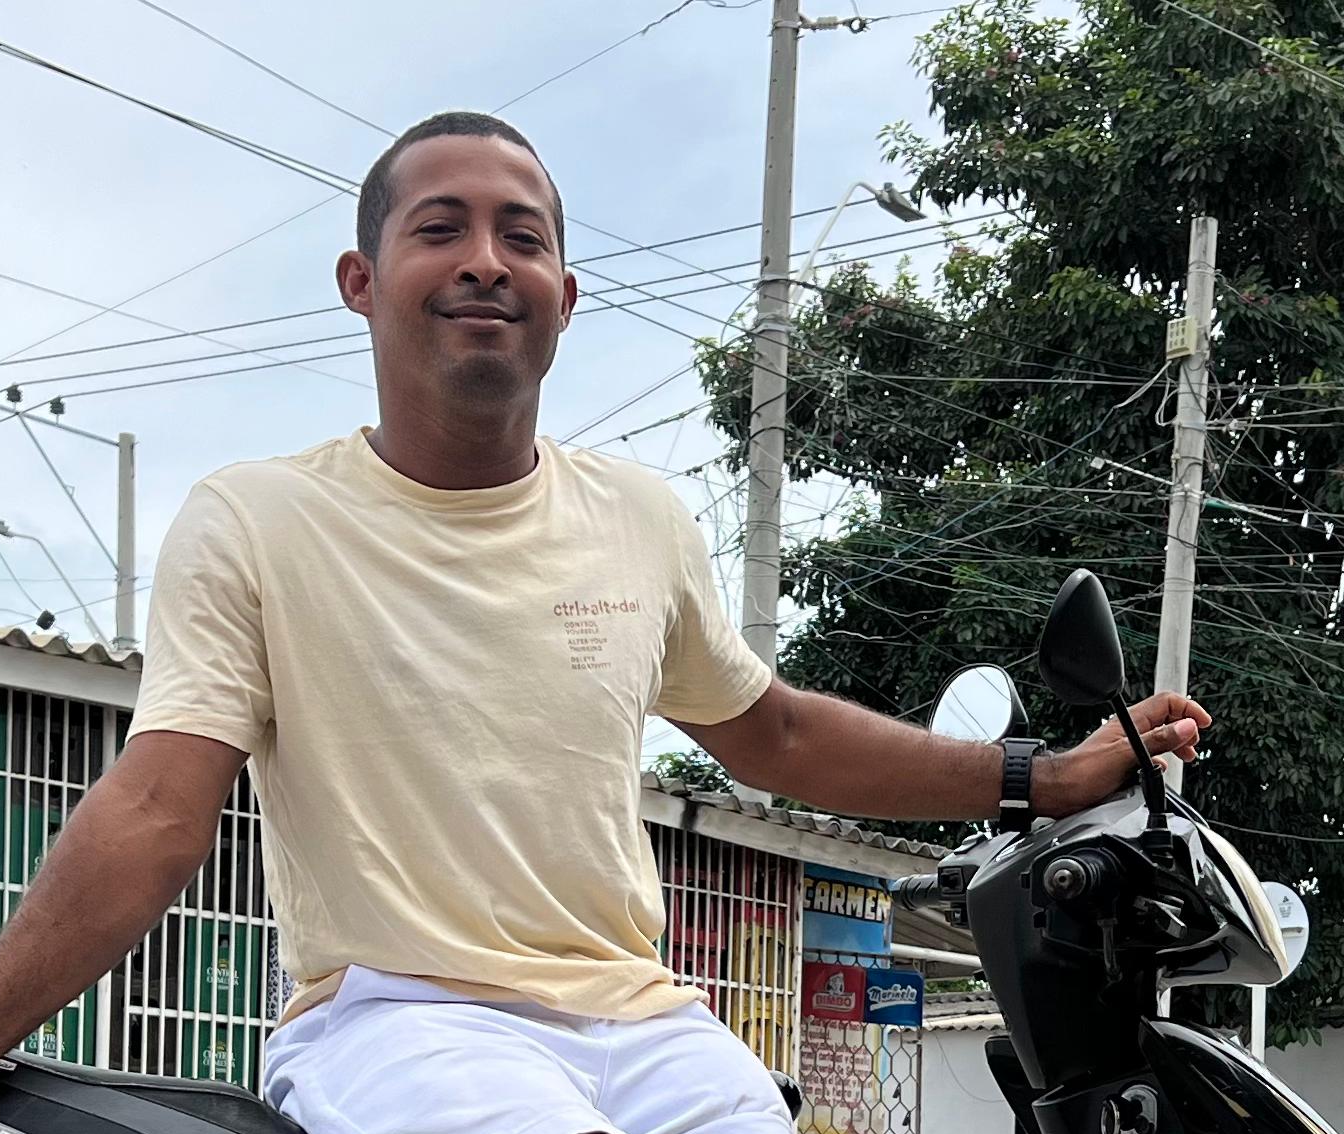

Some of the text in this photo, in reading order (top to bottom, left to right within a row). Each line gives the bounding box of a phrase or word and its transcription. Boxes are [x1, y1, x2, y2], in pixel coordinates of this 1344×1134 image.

[553, 597, 640, 616] ctrl+alt+del
[803, 877, 892, 921] CARMEN
[867, 984, 918, 1003] Marinela
